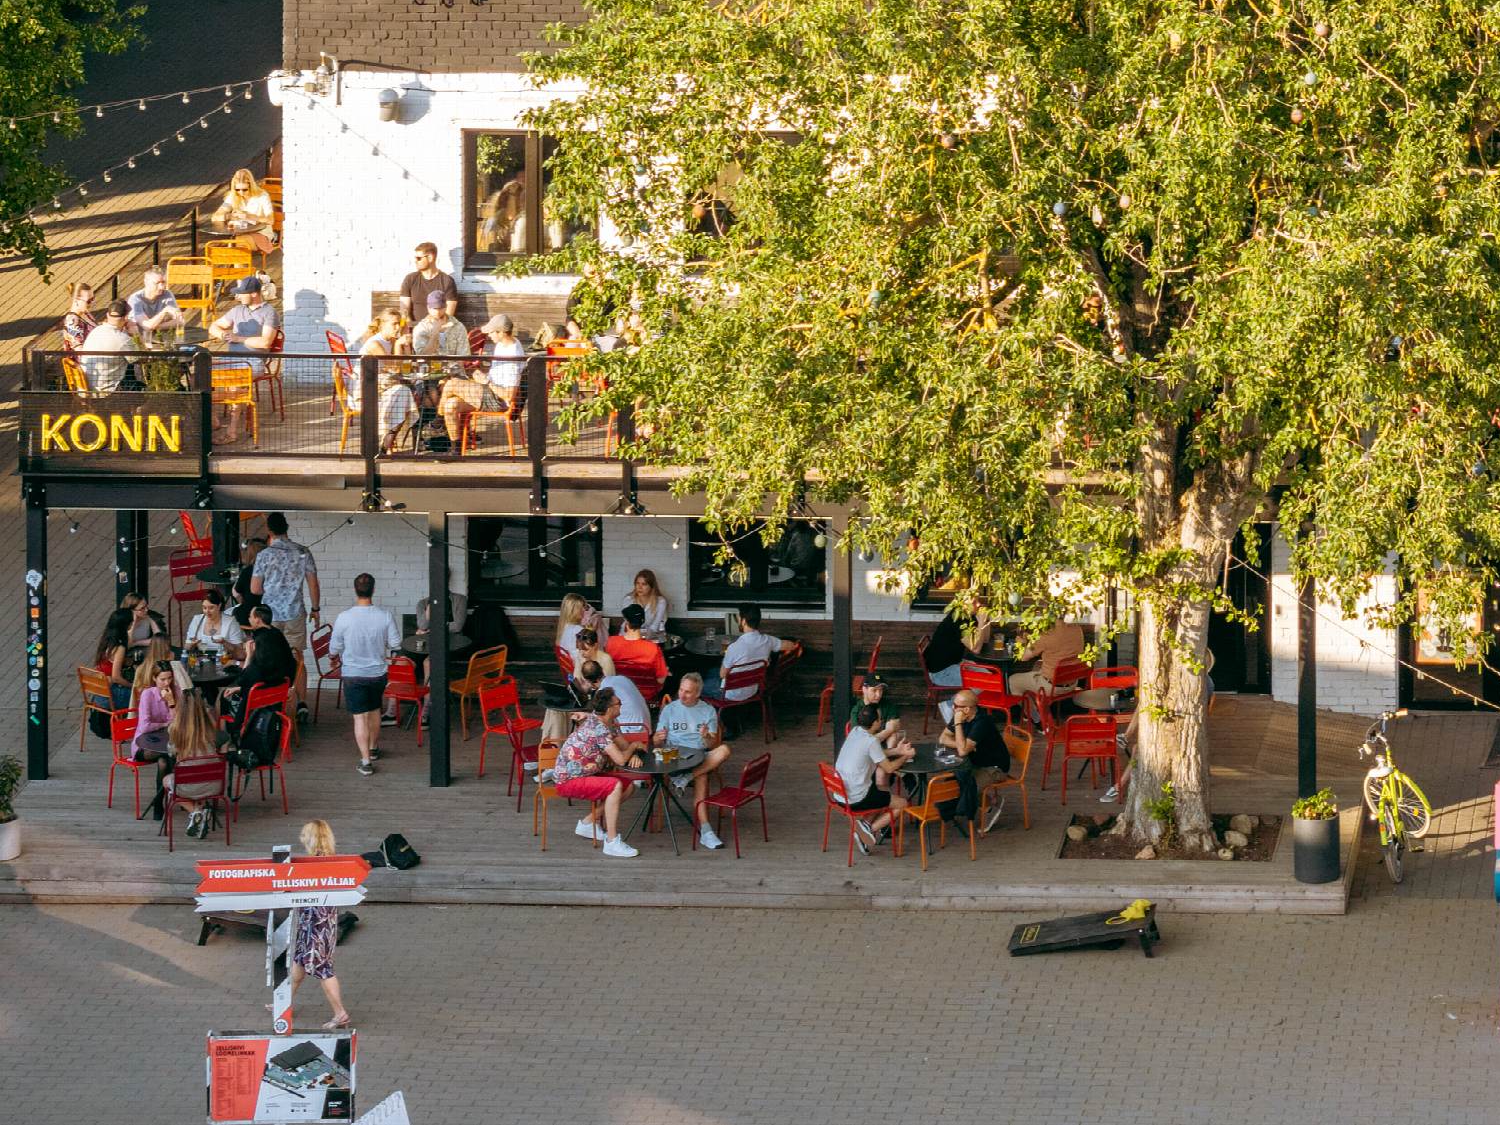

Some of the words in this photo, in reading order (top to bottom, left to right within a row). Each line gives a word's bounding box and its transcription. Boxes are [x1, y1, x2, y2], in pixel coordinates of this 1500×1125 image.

[41, 413, 181, 452] KONN
[209, 868, 276, 879] FOTOGRAFISKA
[271, 879, 318, 888] TELLISKIVI
[320, 877, 355, 886] VÄLJAK
